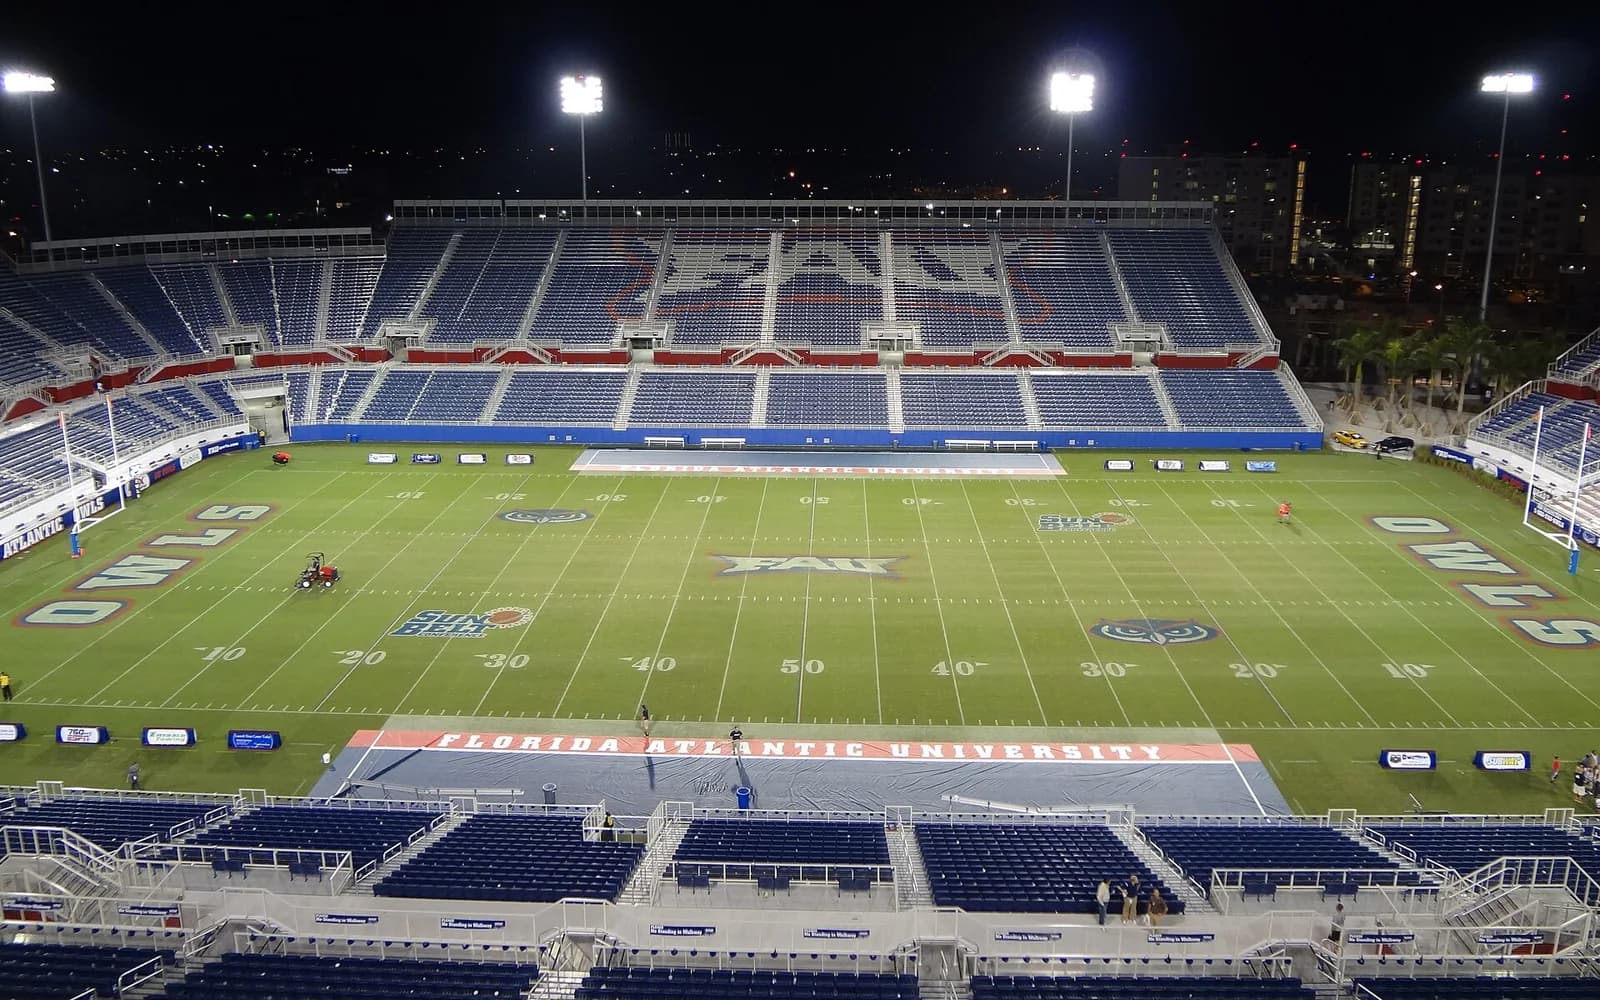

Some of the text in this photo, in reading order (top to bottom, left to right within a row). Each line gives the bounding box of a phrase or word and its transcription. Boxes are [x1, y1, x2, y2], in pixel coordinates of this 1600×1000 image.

[1039, 514, 1102, 523] SUN
[1038, 522, 1114, 531] BELT
[3, 517, 65, 559] ATLANTIC
[24, 504, 272, 624] OWLS
[719, 556, 899, 575] FAU
[1371, 516, 1600, 645] OWLS
[408, 609, 491, 624] SUN
[388, 622, 496, 636] BELT
[202, 647, 246, 661] 10
[337, 650, 387, 665] 20
[483, 654, 531, 668] 30
[632, 657, 677, 672] 40
[780, 659, 825, 674] 50
[930, 661, 975, 676] 40
[1080, 662, 1127, 677] 30
[1228, 662, 1278, 678] 20
[1381, 663, 1428, 678] 10
[437, 734, 1161, 760] FLORIDA ATLANTIC UNIVERSITY
